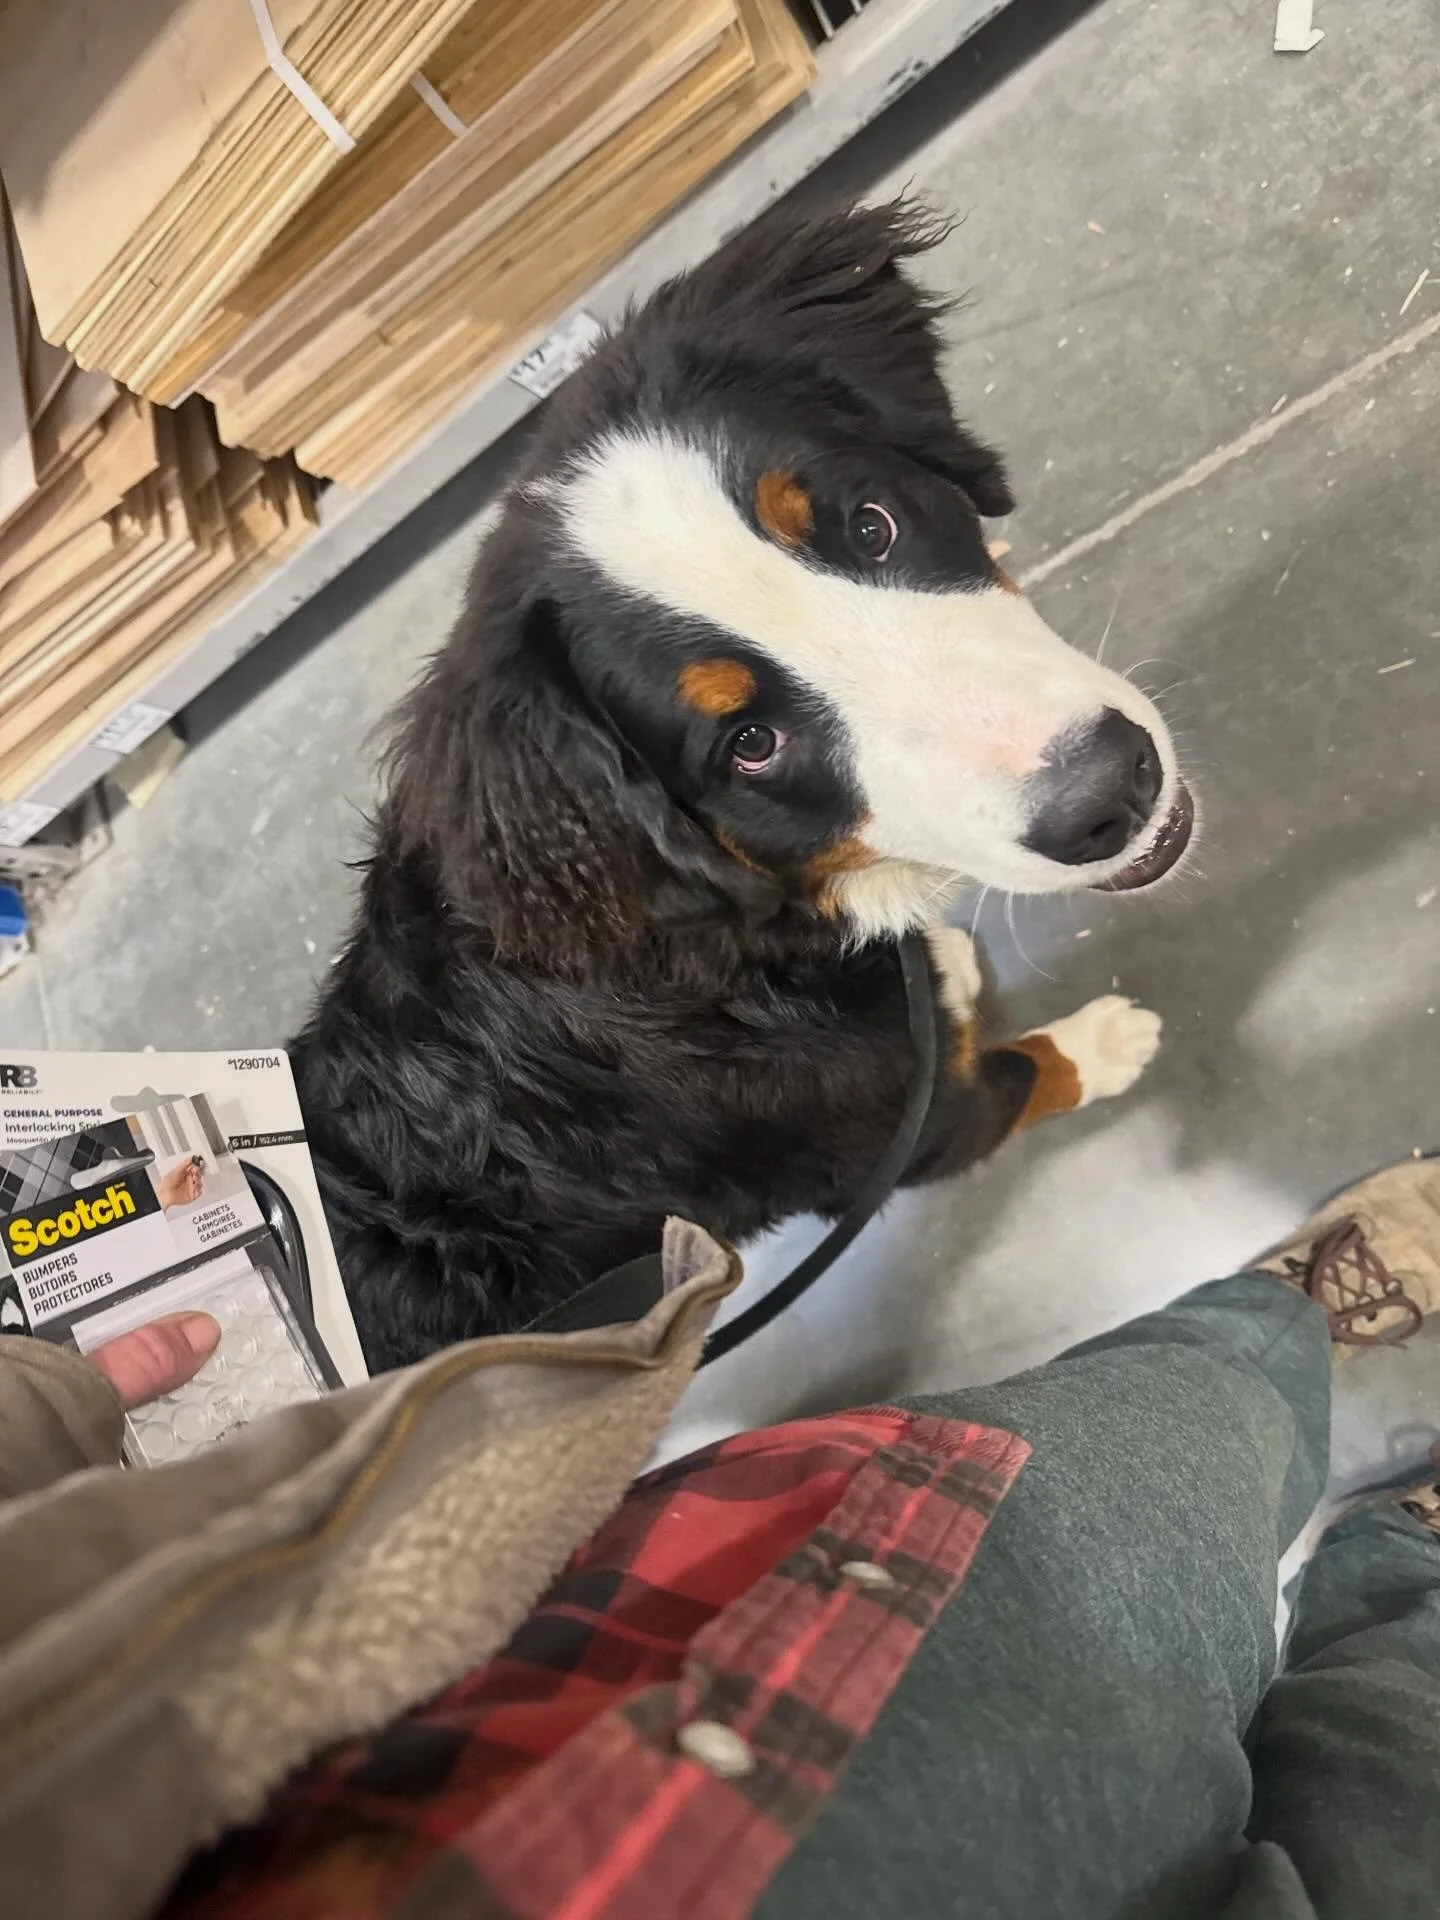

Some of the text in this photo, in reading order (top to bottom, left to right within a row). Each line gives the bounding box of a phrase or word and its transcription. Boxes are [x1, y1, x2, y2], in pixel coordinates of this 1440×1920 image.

[3, 1108, 103, 1118] GENERAL PURPOSE
[5, 1121, 76, 1133] Interlocking
[232, 1138, 240, 1148] 6
[241, 1137, 251, 1147] in
[278, 1135, 294, 1143] mm
[9, 1186, 136, 1256] Scotch
[192, 1203, 231, 1225] CABINETS
[197, 1211, 236, 1235] ARMOIRES
[200, 1219, 243, 1243] GABINETES
[22, 1252, 78, 1285] BUMPERS
[28, 1270, 78, 1300] BUTOIRS
[33, 1272, 114, 1316] PROTECTORES
